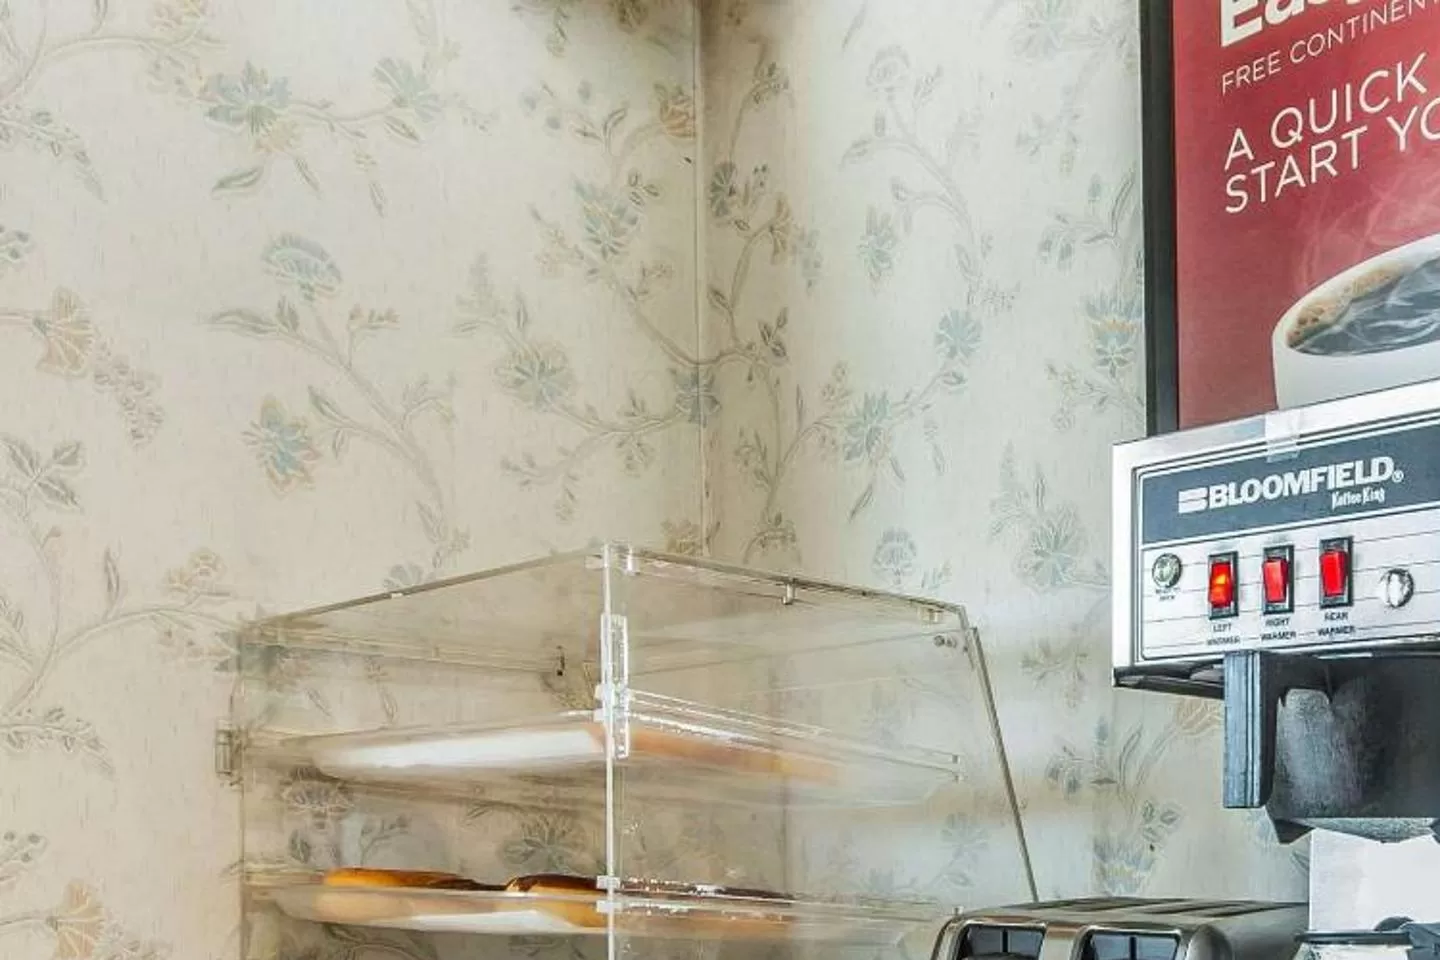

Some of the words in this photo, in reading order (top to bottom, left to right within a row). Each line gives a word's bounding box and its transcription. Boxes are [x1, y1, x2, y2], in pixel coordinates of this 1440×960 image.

[1222, 50, 1282, 96] FREE
[1290, 0, 1439, 64] CONTINEN
[1225, 128, 1254, 170] A
[1270, 53, 1427, 149] QUICK
[1225, 127, 1367, 214] START
[1212, 623, 1232, 633] LEFT
